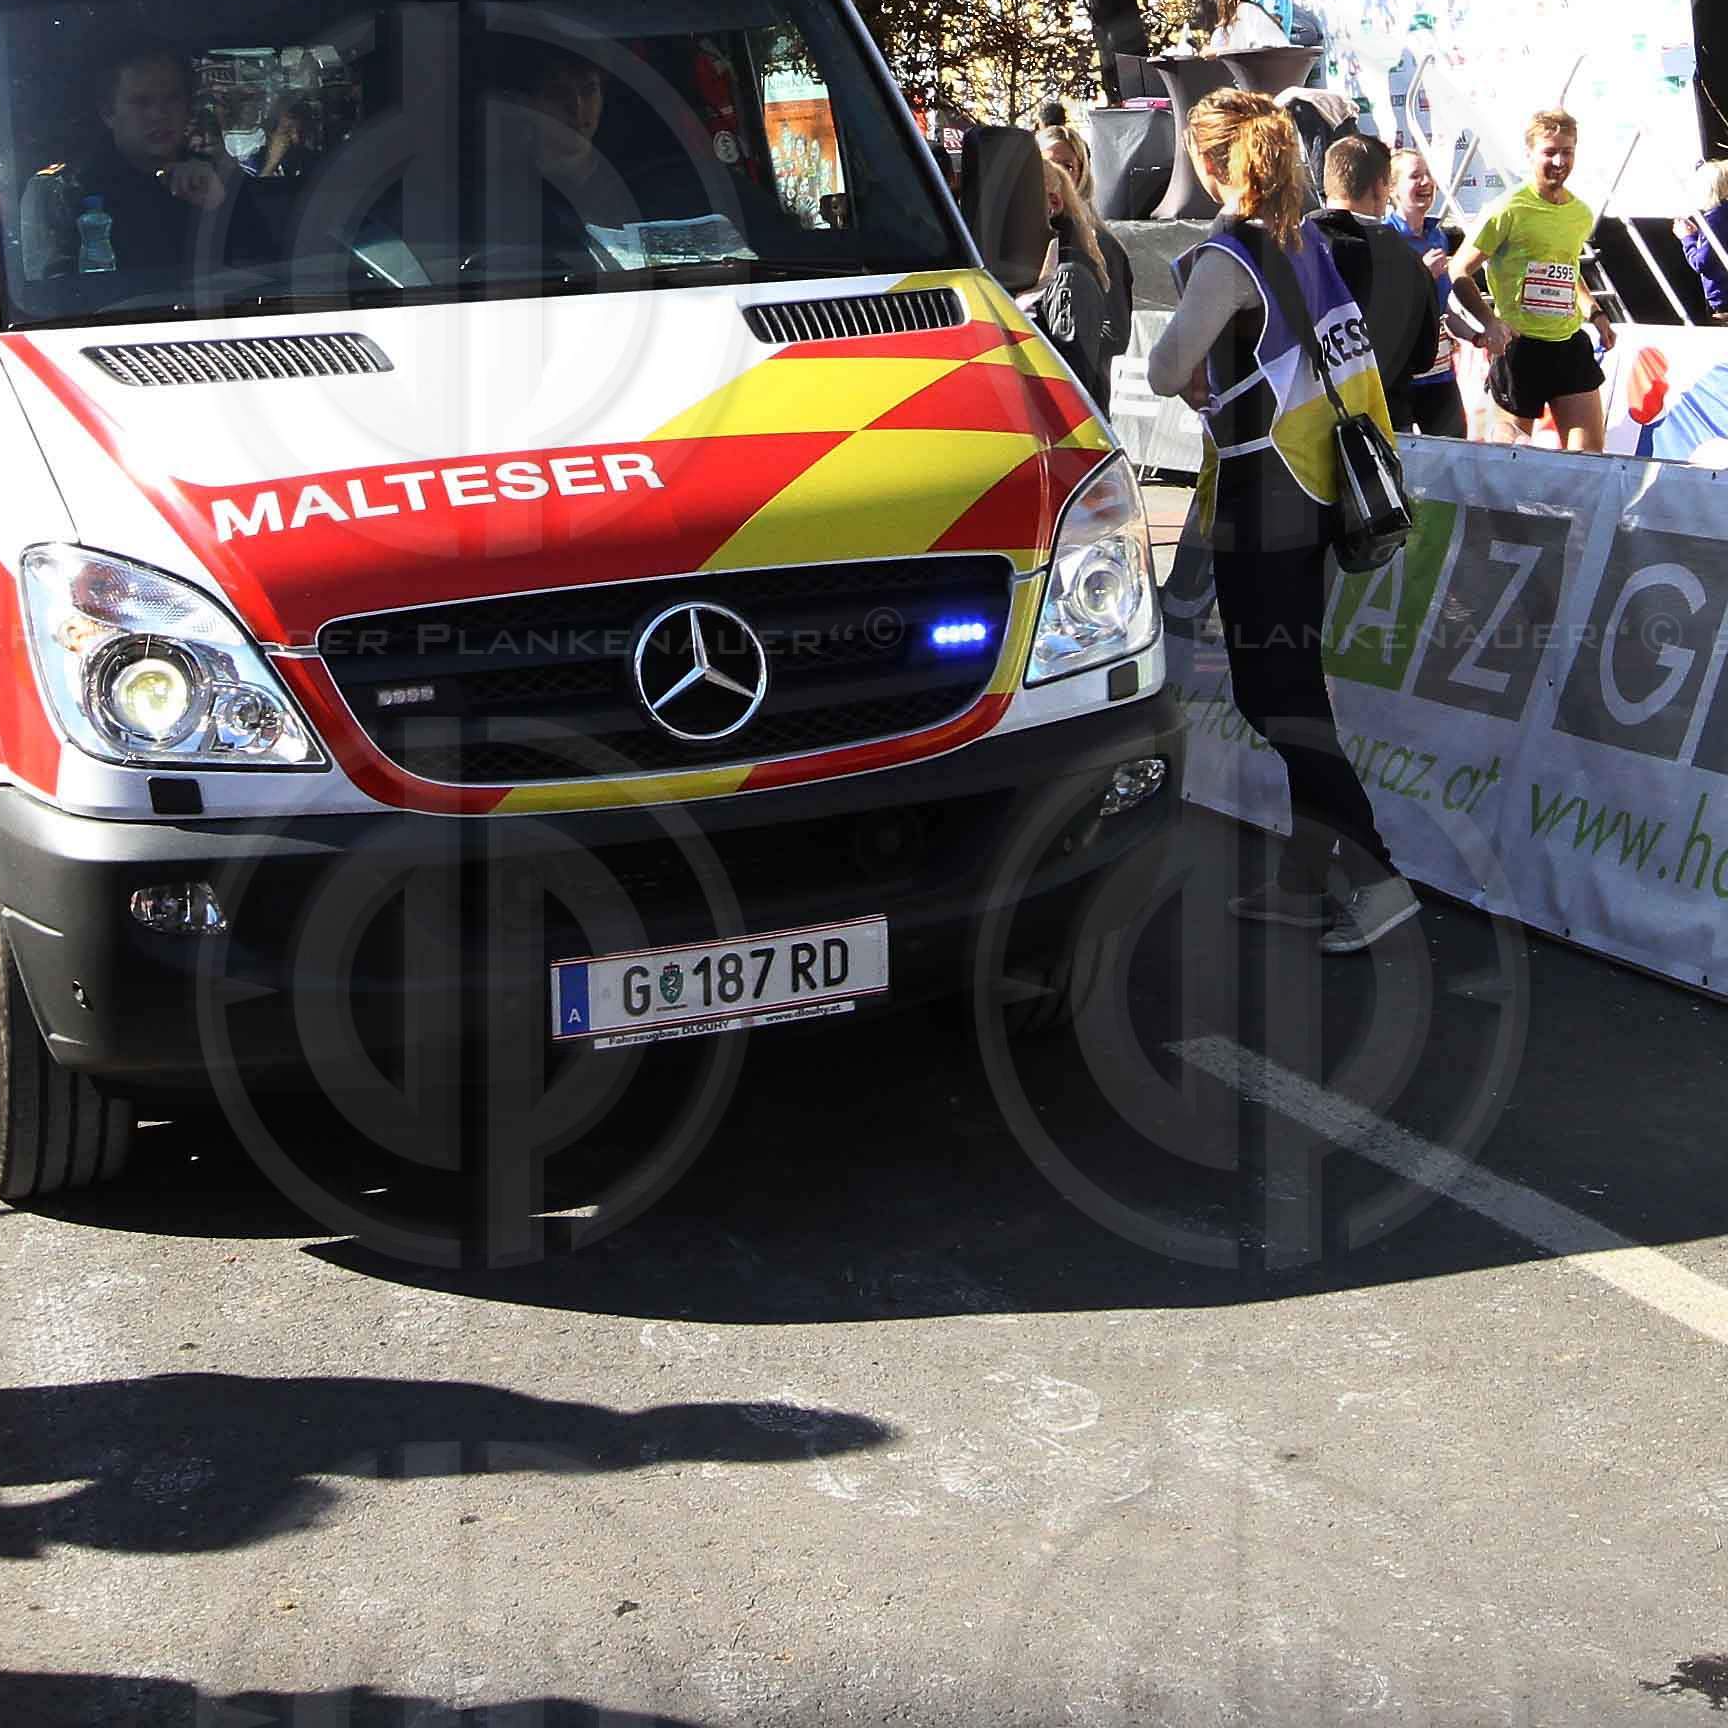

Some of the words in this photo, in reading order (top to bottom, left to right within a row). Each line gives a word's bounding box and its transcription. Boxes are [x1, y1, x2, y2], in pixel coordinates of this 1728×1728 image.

[1320, 316, 1375, 370] RESS
[210, 452, 666, 543] MALTESER
[622, 965, 652, 1017] G
[691, 946, 777, 1008] 187
[790, 937, 850, 993] RD
[567, 1008, 582, 1024] A
[608, 1028, 681, 1046] Fahrzeugbau
[681, 1019, 731, 1038] DLOUHY
[765, 1003, 842, 1023] www.dlouhy.at
